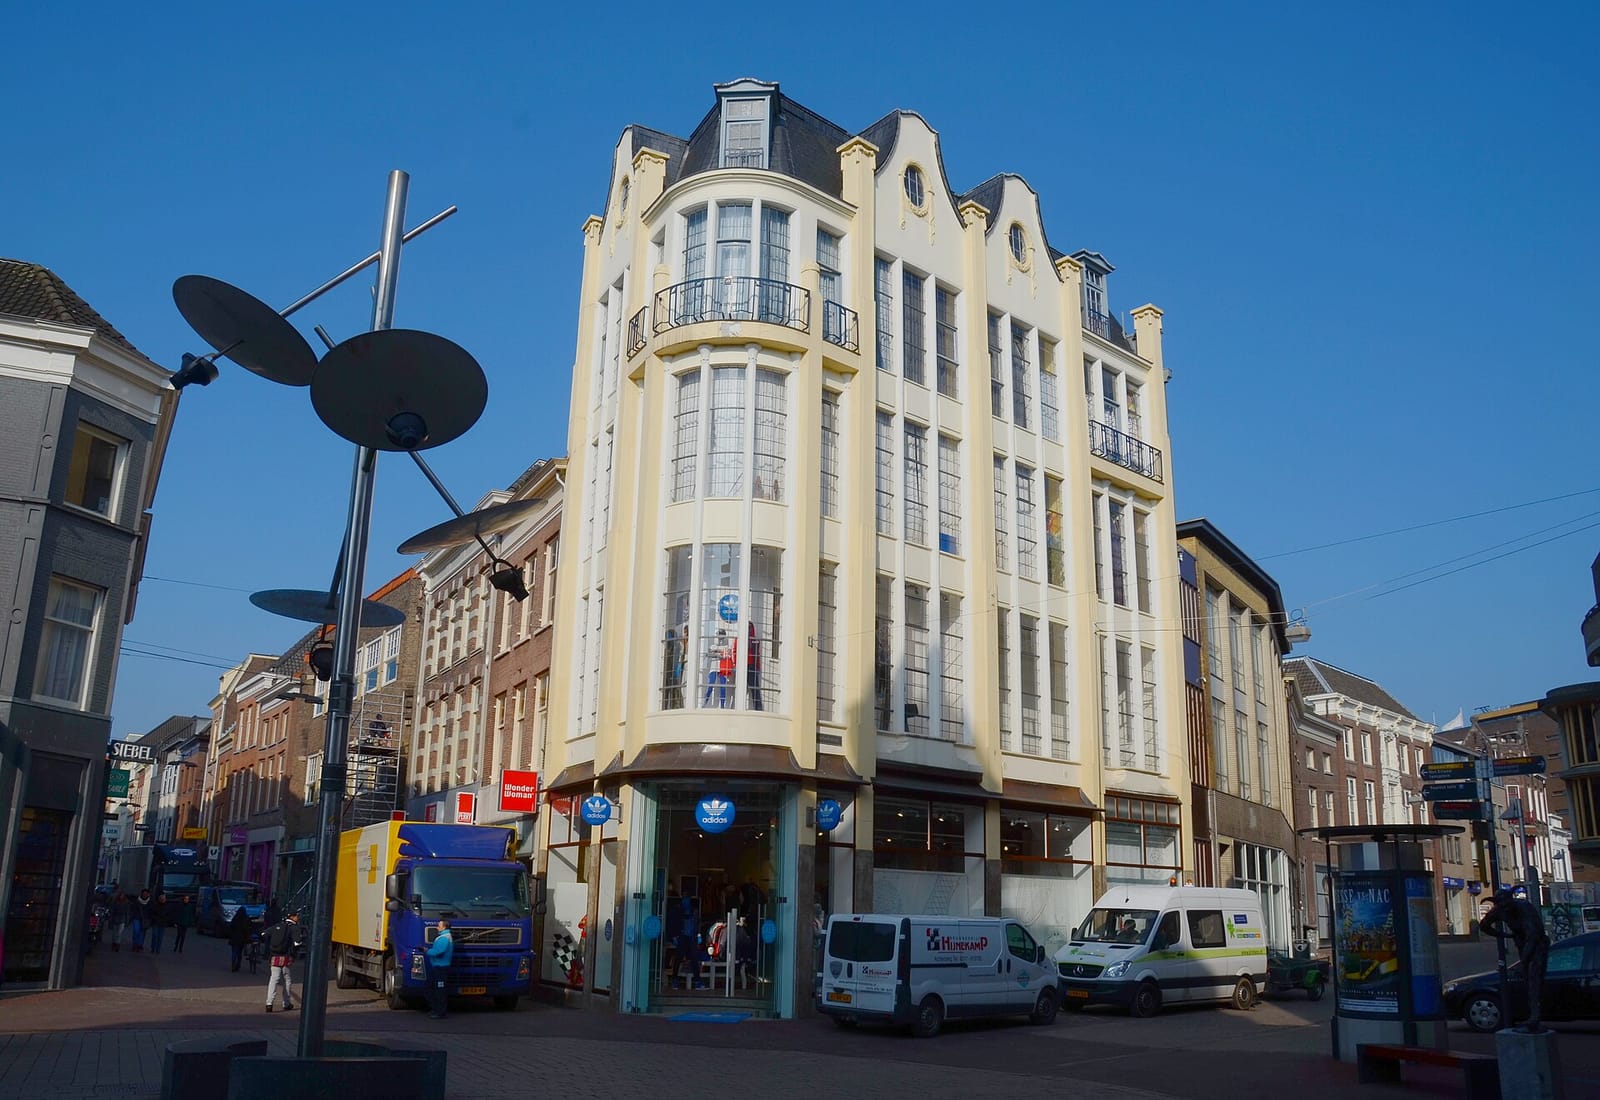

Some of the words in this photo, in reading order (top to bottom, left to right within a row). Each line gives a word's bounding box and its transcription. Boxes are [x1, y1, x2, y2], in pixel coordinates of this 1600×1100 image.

[113, 742, 153, 761] SIEBEL
[504, 783, 535, 791] Wonder
[504, 790, 533, 799] Woman
[587, 812, 606, 820] adidas
[702, 815, 728, 824] adidas
[1368, 888, 1391, 904] NAC
